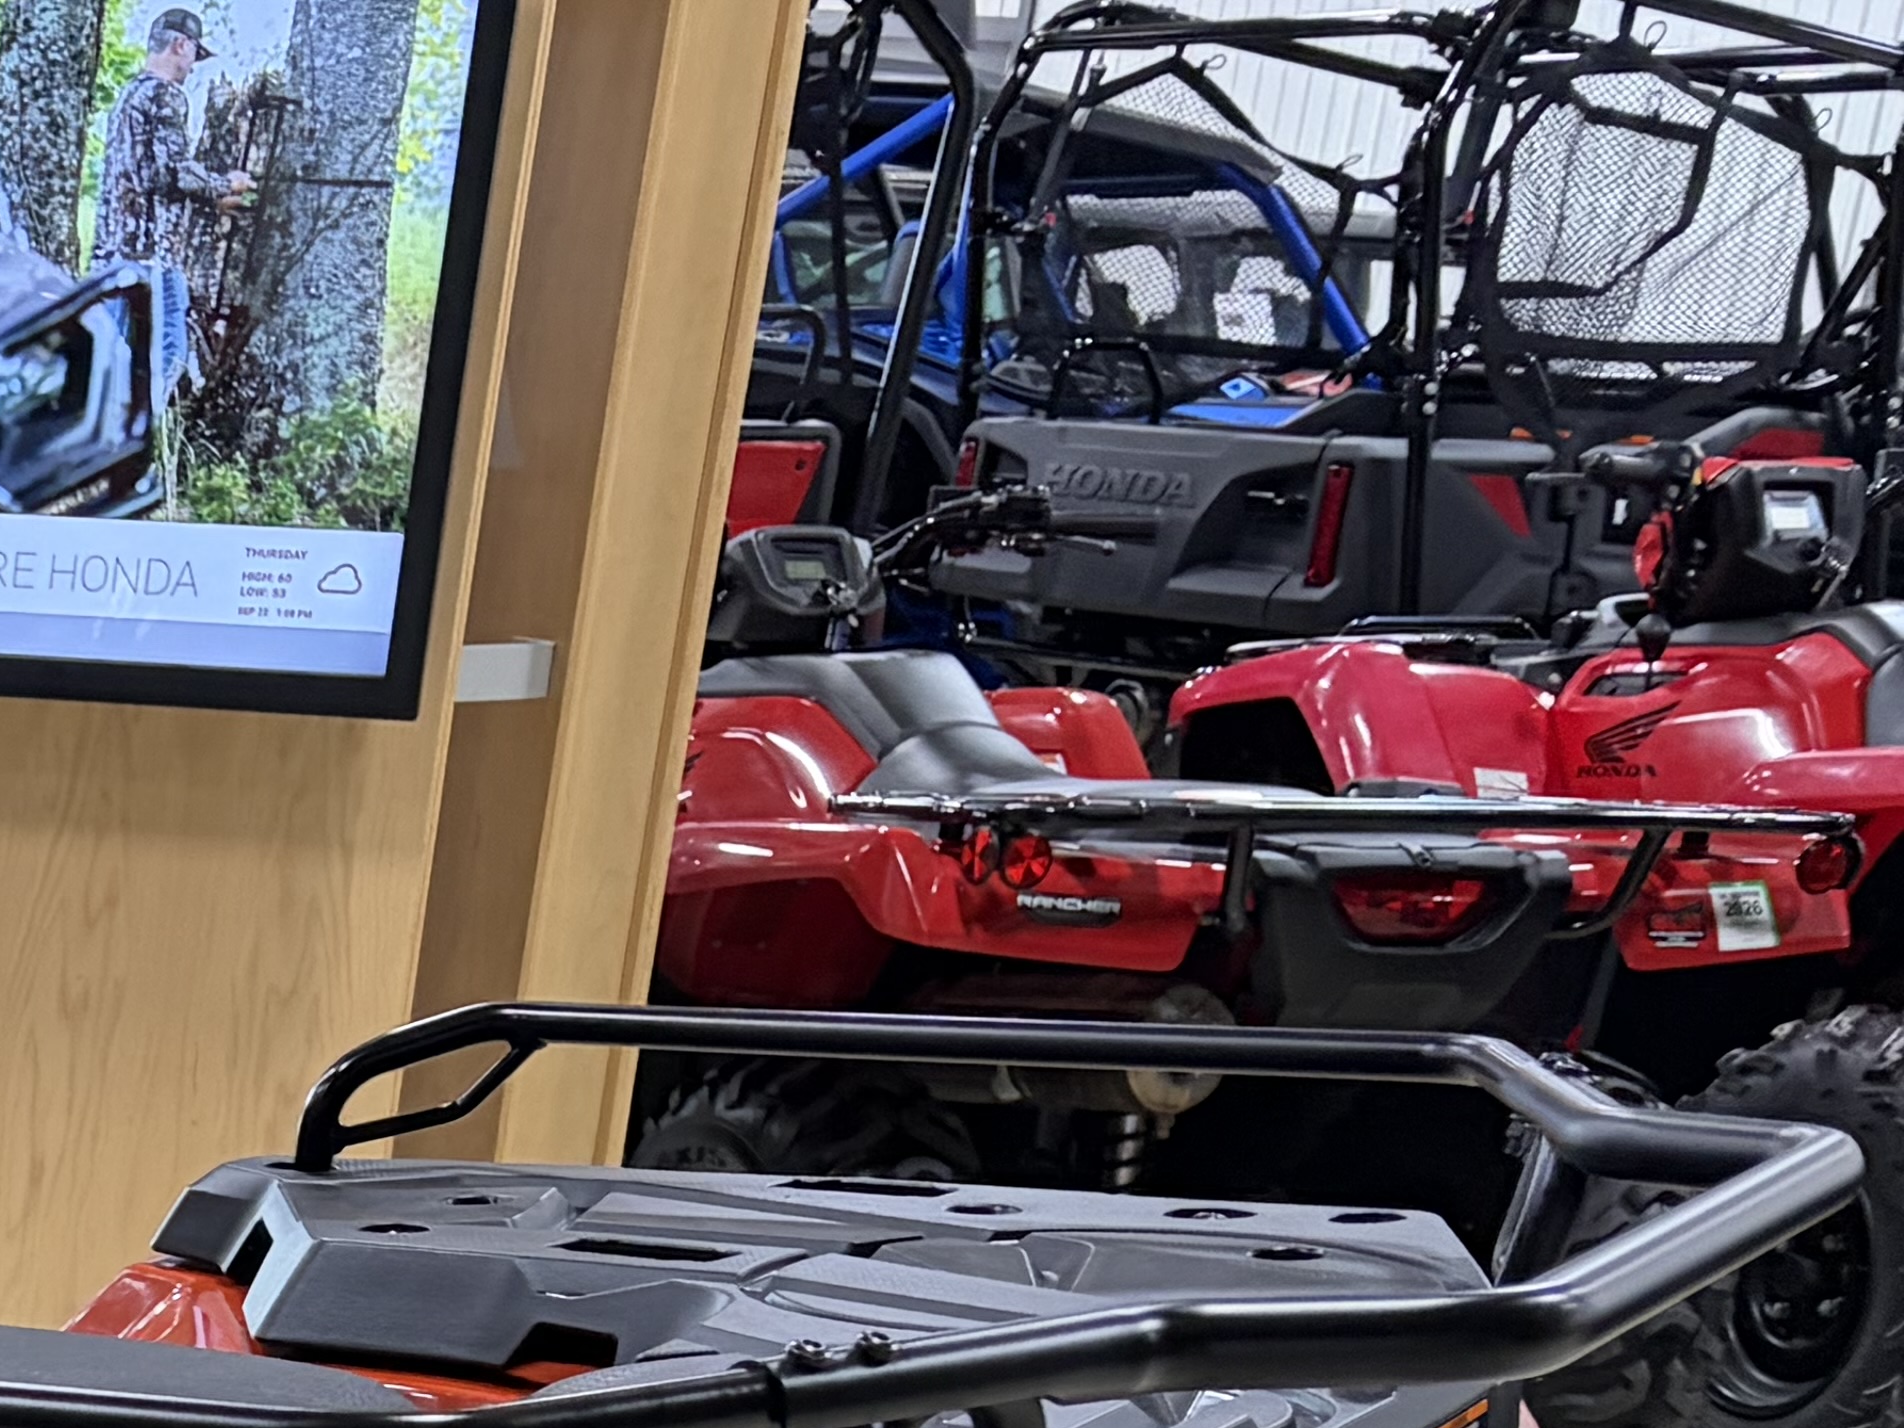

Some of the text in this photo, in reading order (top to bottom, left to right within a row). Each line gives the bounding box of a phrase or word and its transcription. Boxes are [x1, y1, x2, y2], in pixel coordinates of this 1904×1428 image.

[1045, 463, 1196, 509] HONDA
[245, 547, 308, 560] THURSDAY
[48, 553, 198, 598] HONDA
[1576, 764, 1657, 778] HONDA
[1017, 894, 1121, 916] RANCHER
